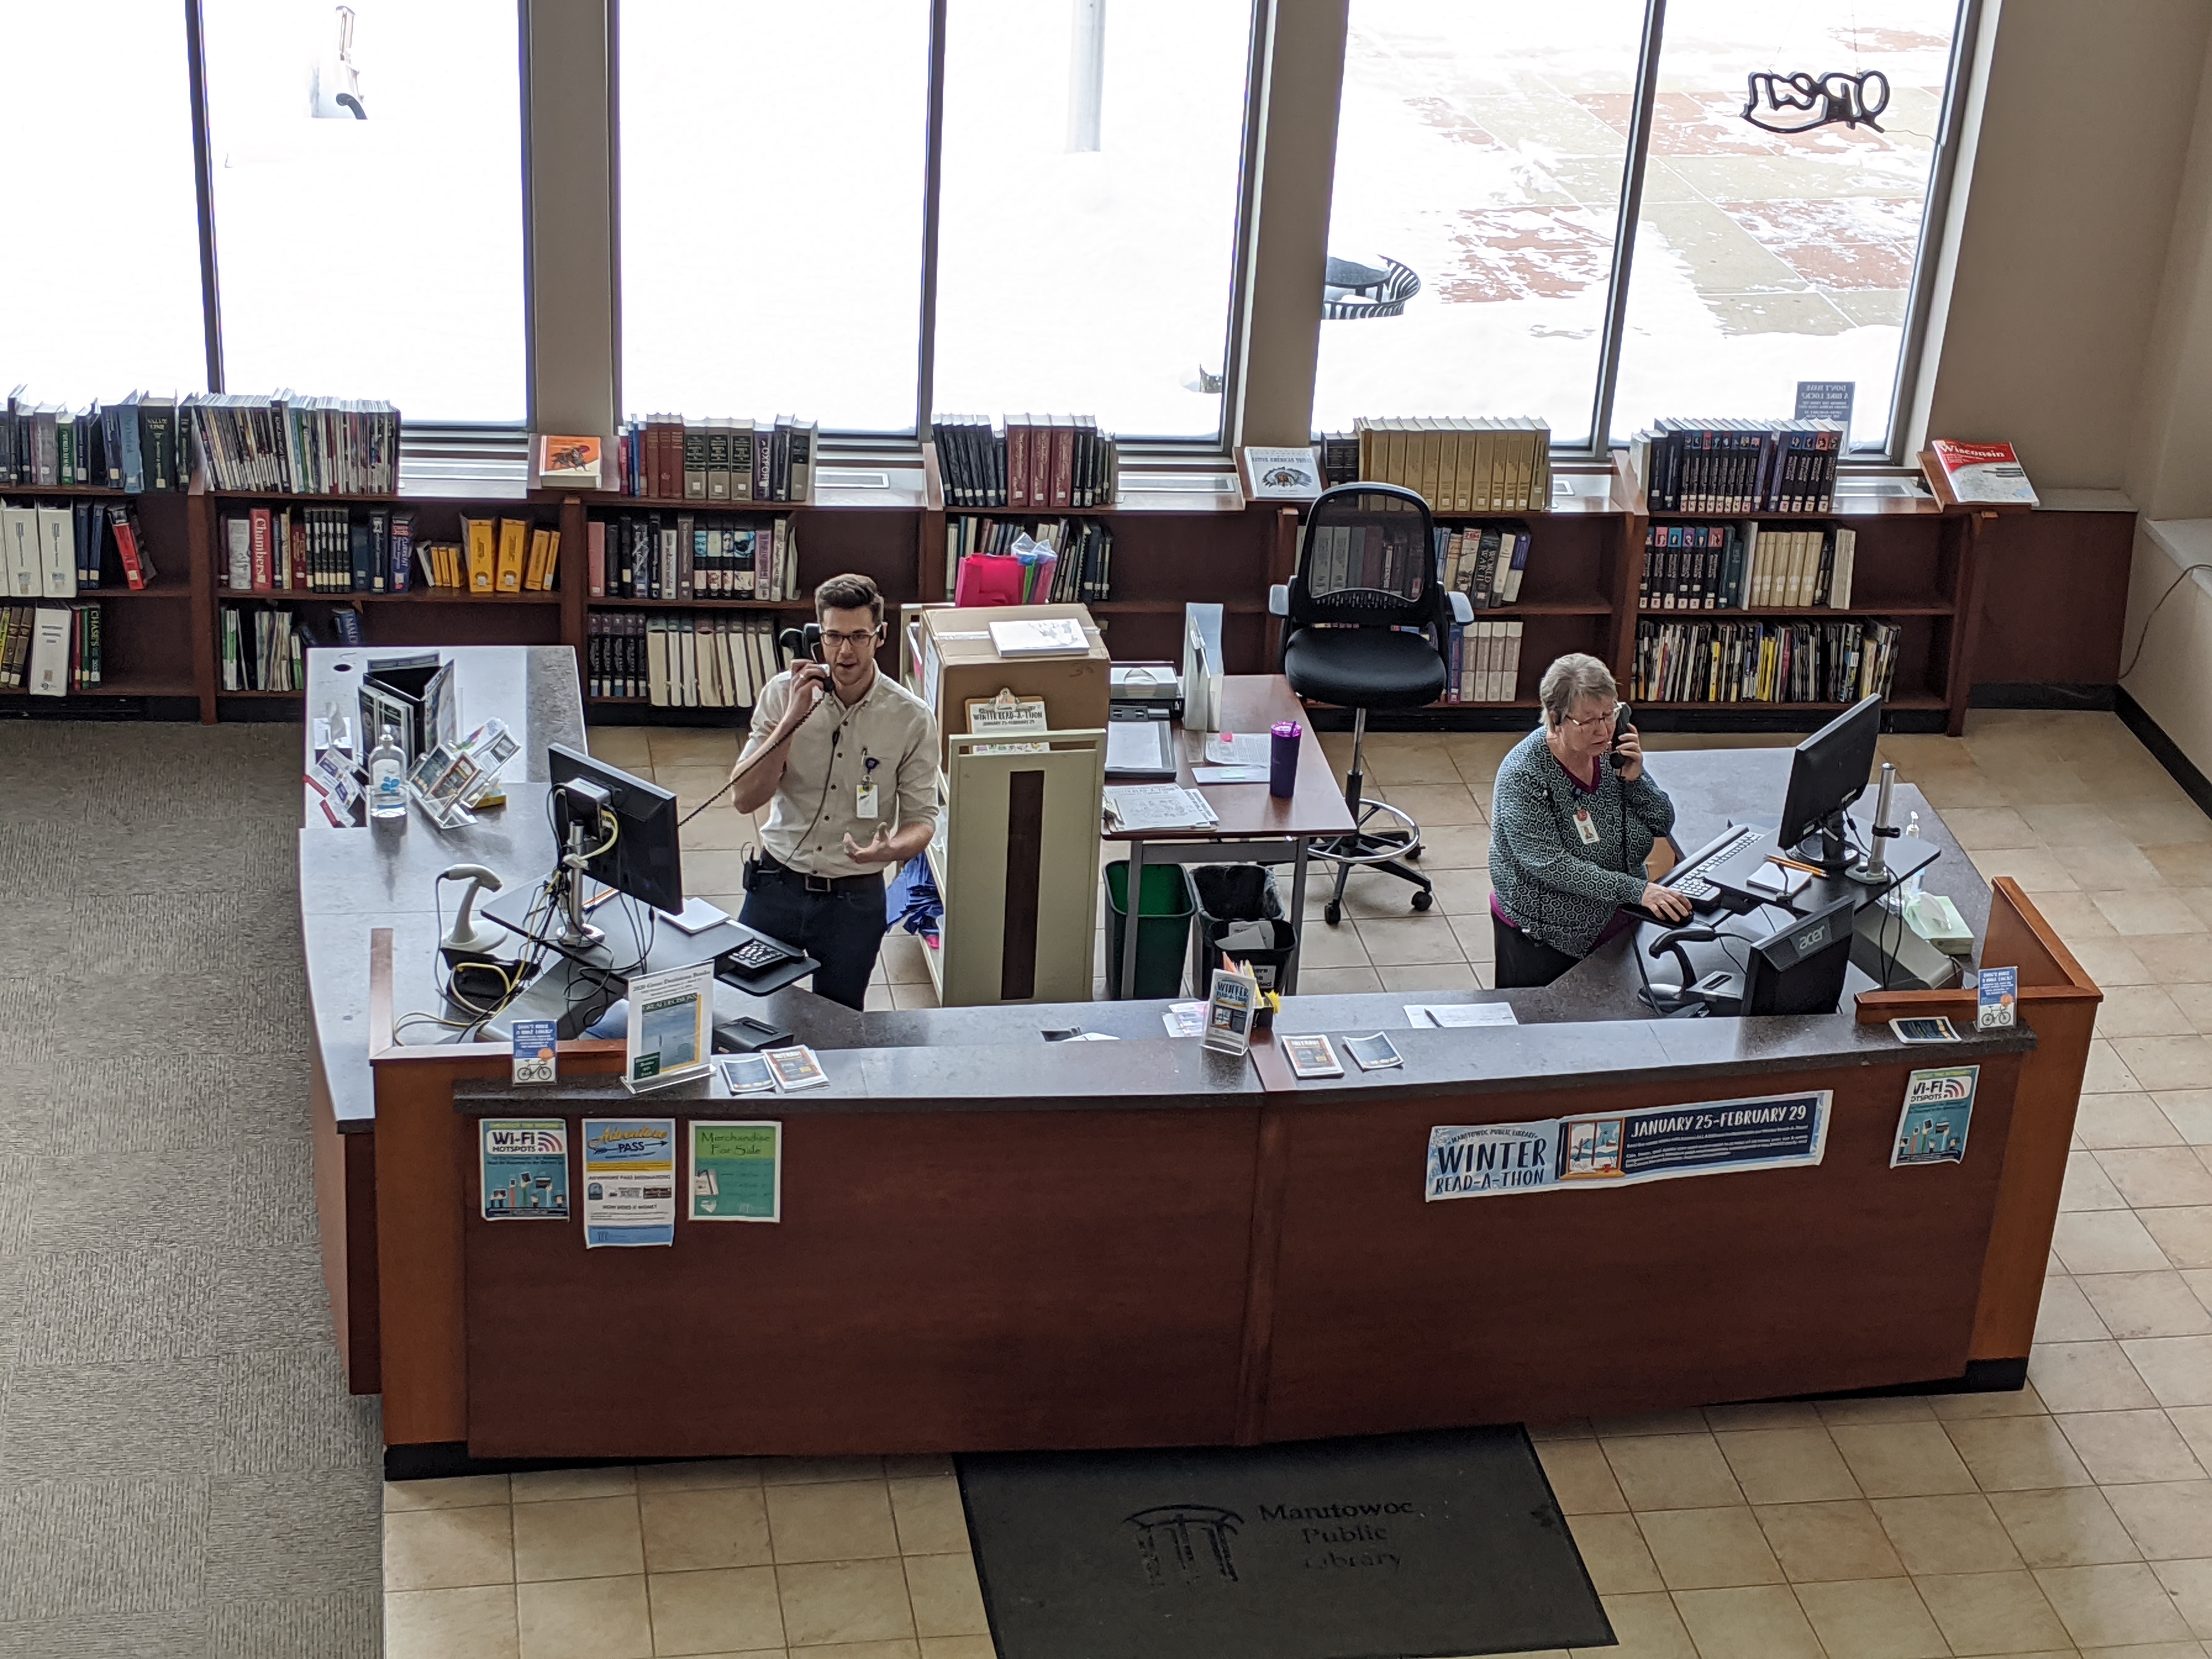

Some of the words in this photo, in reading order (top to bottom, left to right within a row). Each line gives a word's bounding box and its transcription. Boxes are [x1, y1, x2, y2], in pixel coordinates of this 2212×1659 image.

[1940, 443, 2005, 458] Wisconsin
[255, 517, 267, 576] Chambers
[1478, 549, 1489, 571] WAR
[1485, 549, 1497, 583] WORLD
[1799, 926, 1825, 950] acer
[1631, 1116, 1695, 1138] JANUARY
[1695, 1106, 1787, 1130] 25-FEBRUARY
[1788, 1104, 1807, 1121] 29
[618, 1141, 645, 1153] PASS
[711, 1144, 731, 1155] For
[735, 1144, 761, 1155] Sale
[1437, 1138, 1547, 1175] WINTER
[1435, 1168, 1544, 1193] READ-A-THON
[1260, 1502, 1415, 1521] Manitowoc
[1301, 1525, 1388, 1544] Public
